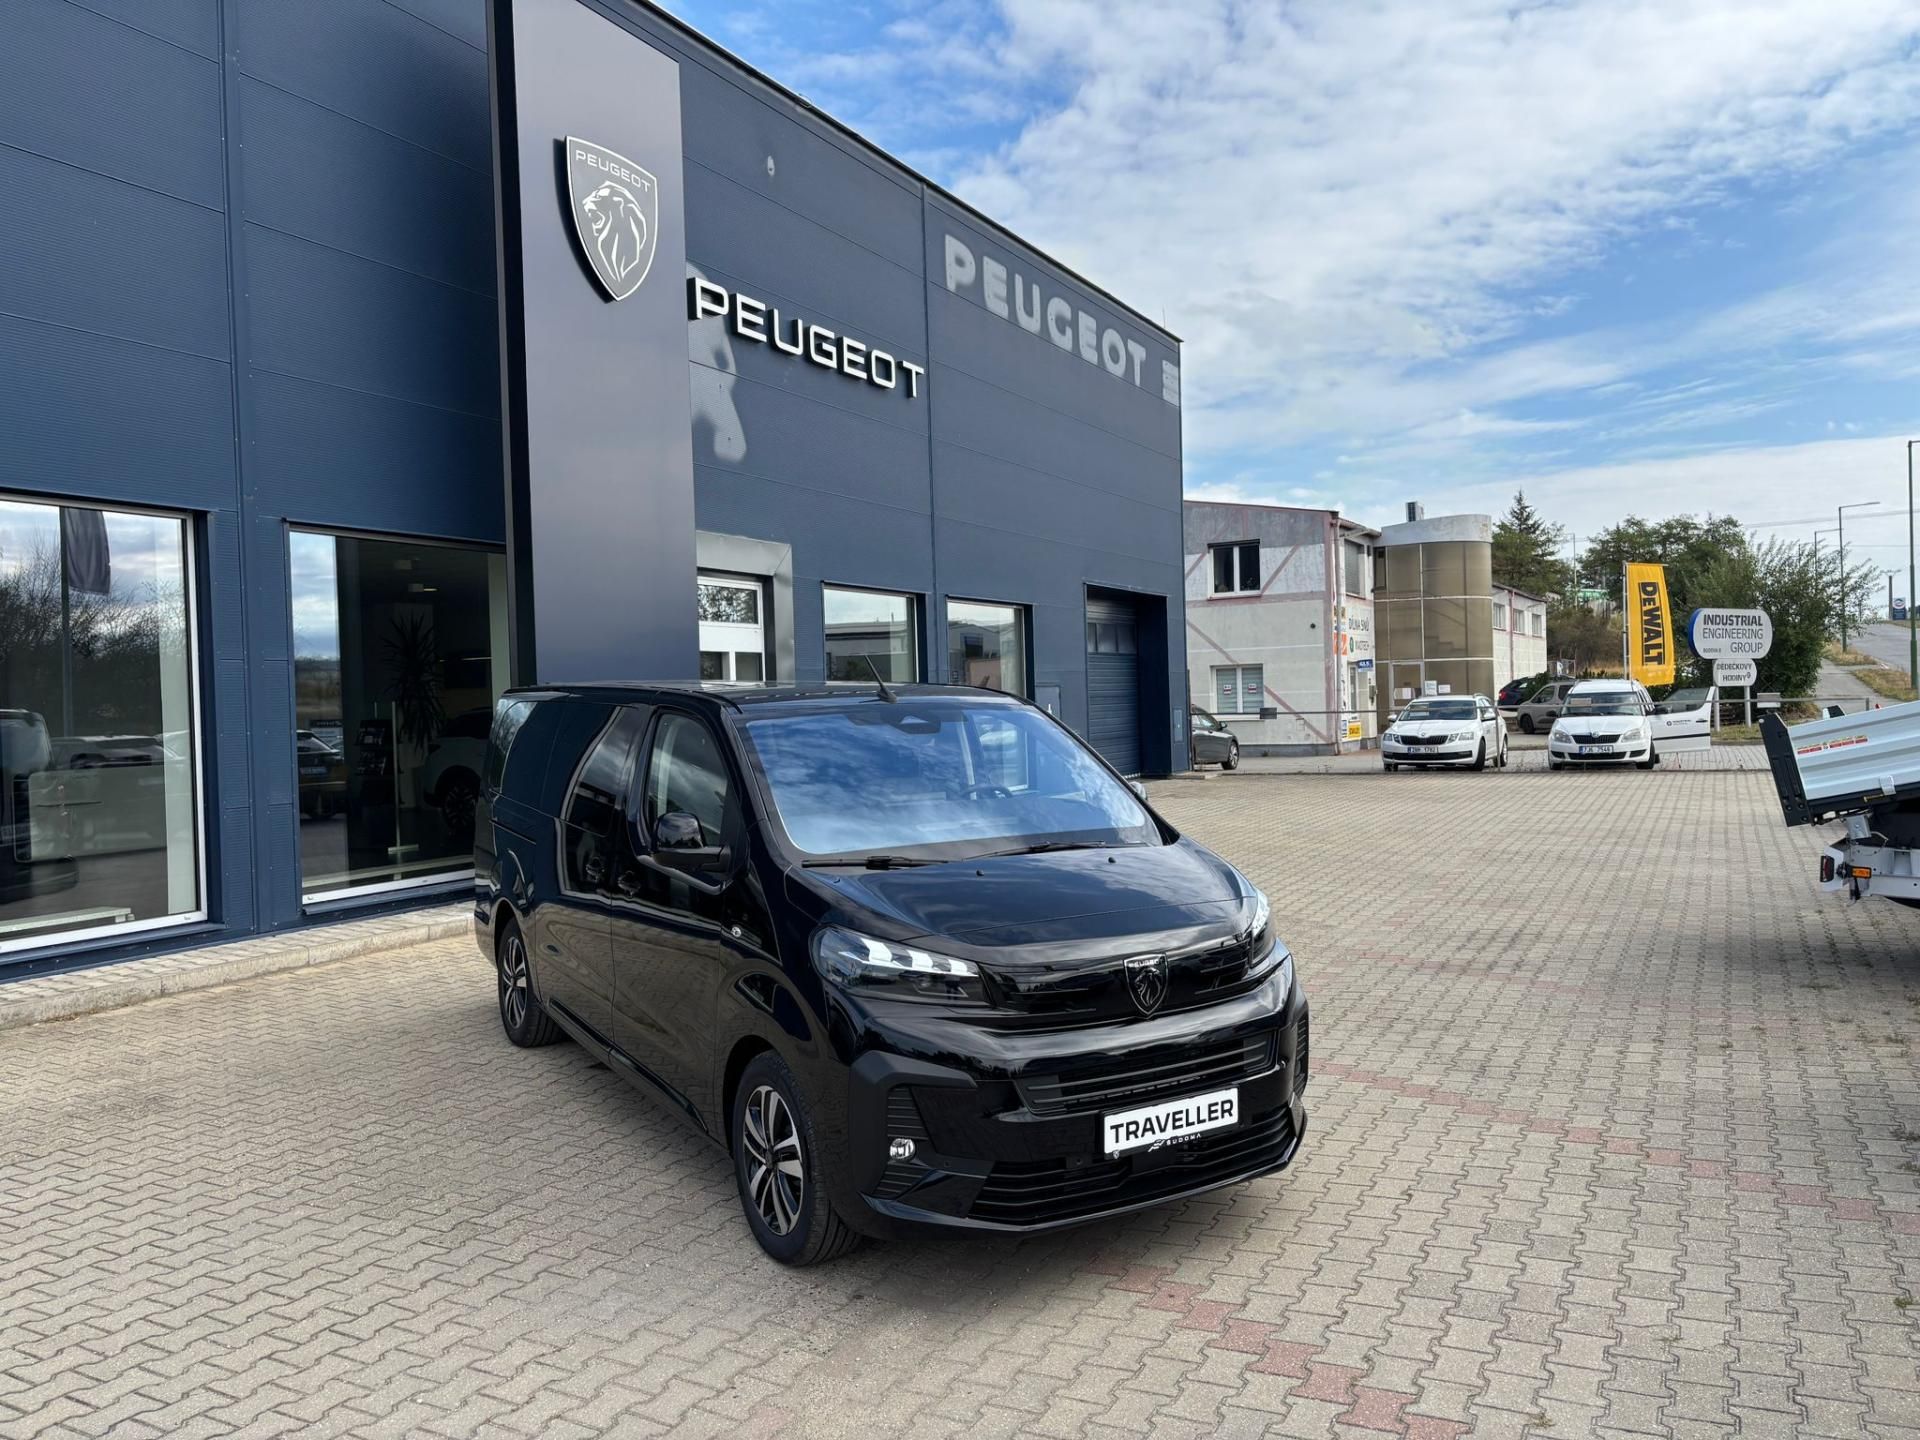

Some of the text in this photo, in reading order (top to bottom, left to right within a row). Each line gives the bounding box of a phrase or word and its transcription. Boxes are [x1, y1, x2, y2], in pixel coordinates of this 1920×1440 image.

[576, 150, 651, 192] PEUGEOT
[945, 234, 1146, 387] PEUGEOT
[692, 277, 924, 398] PEUGEOT
[1703, 614, 1763, 626] INDUSTRIAL
[1703, 628, 1763, 639] ENGINEERING
[1730, 642, 1763, 653] GROUP
[1110, 1099, 1234, 1143] TRAVELLER
